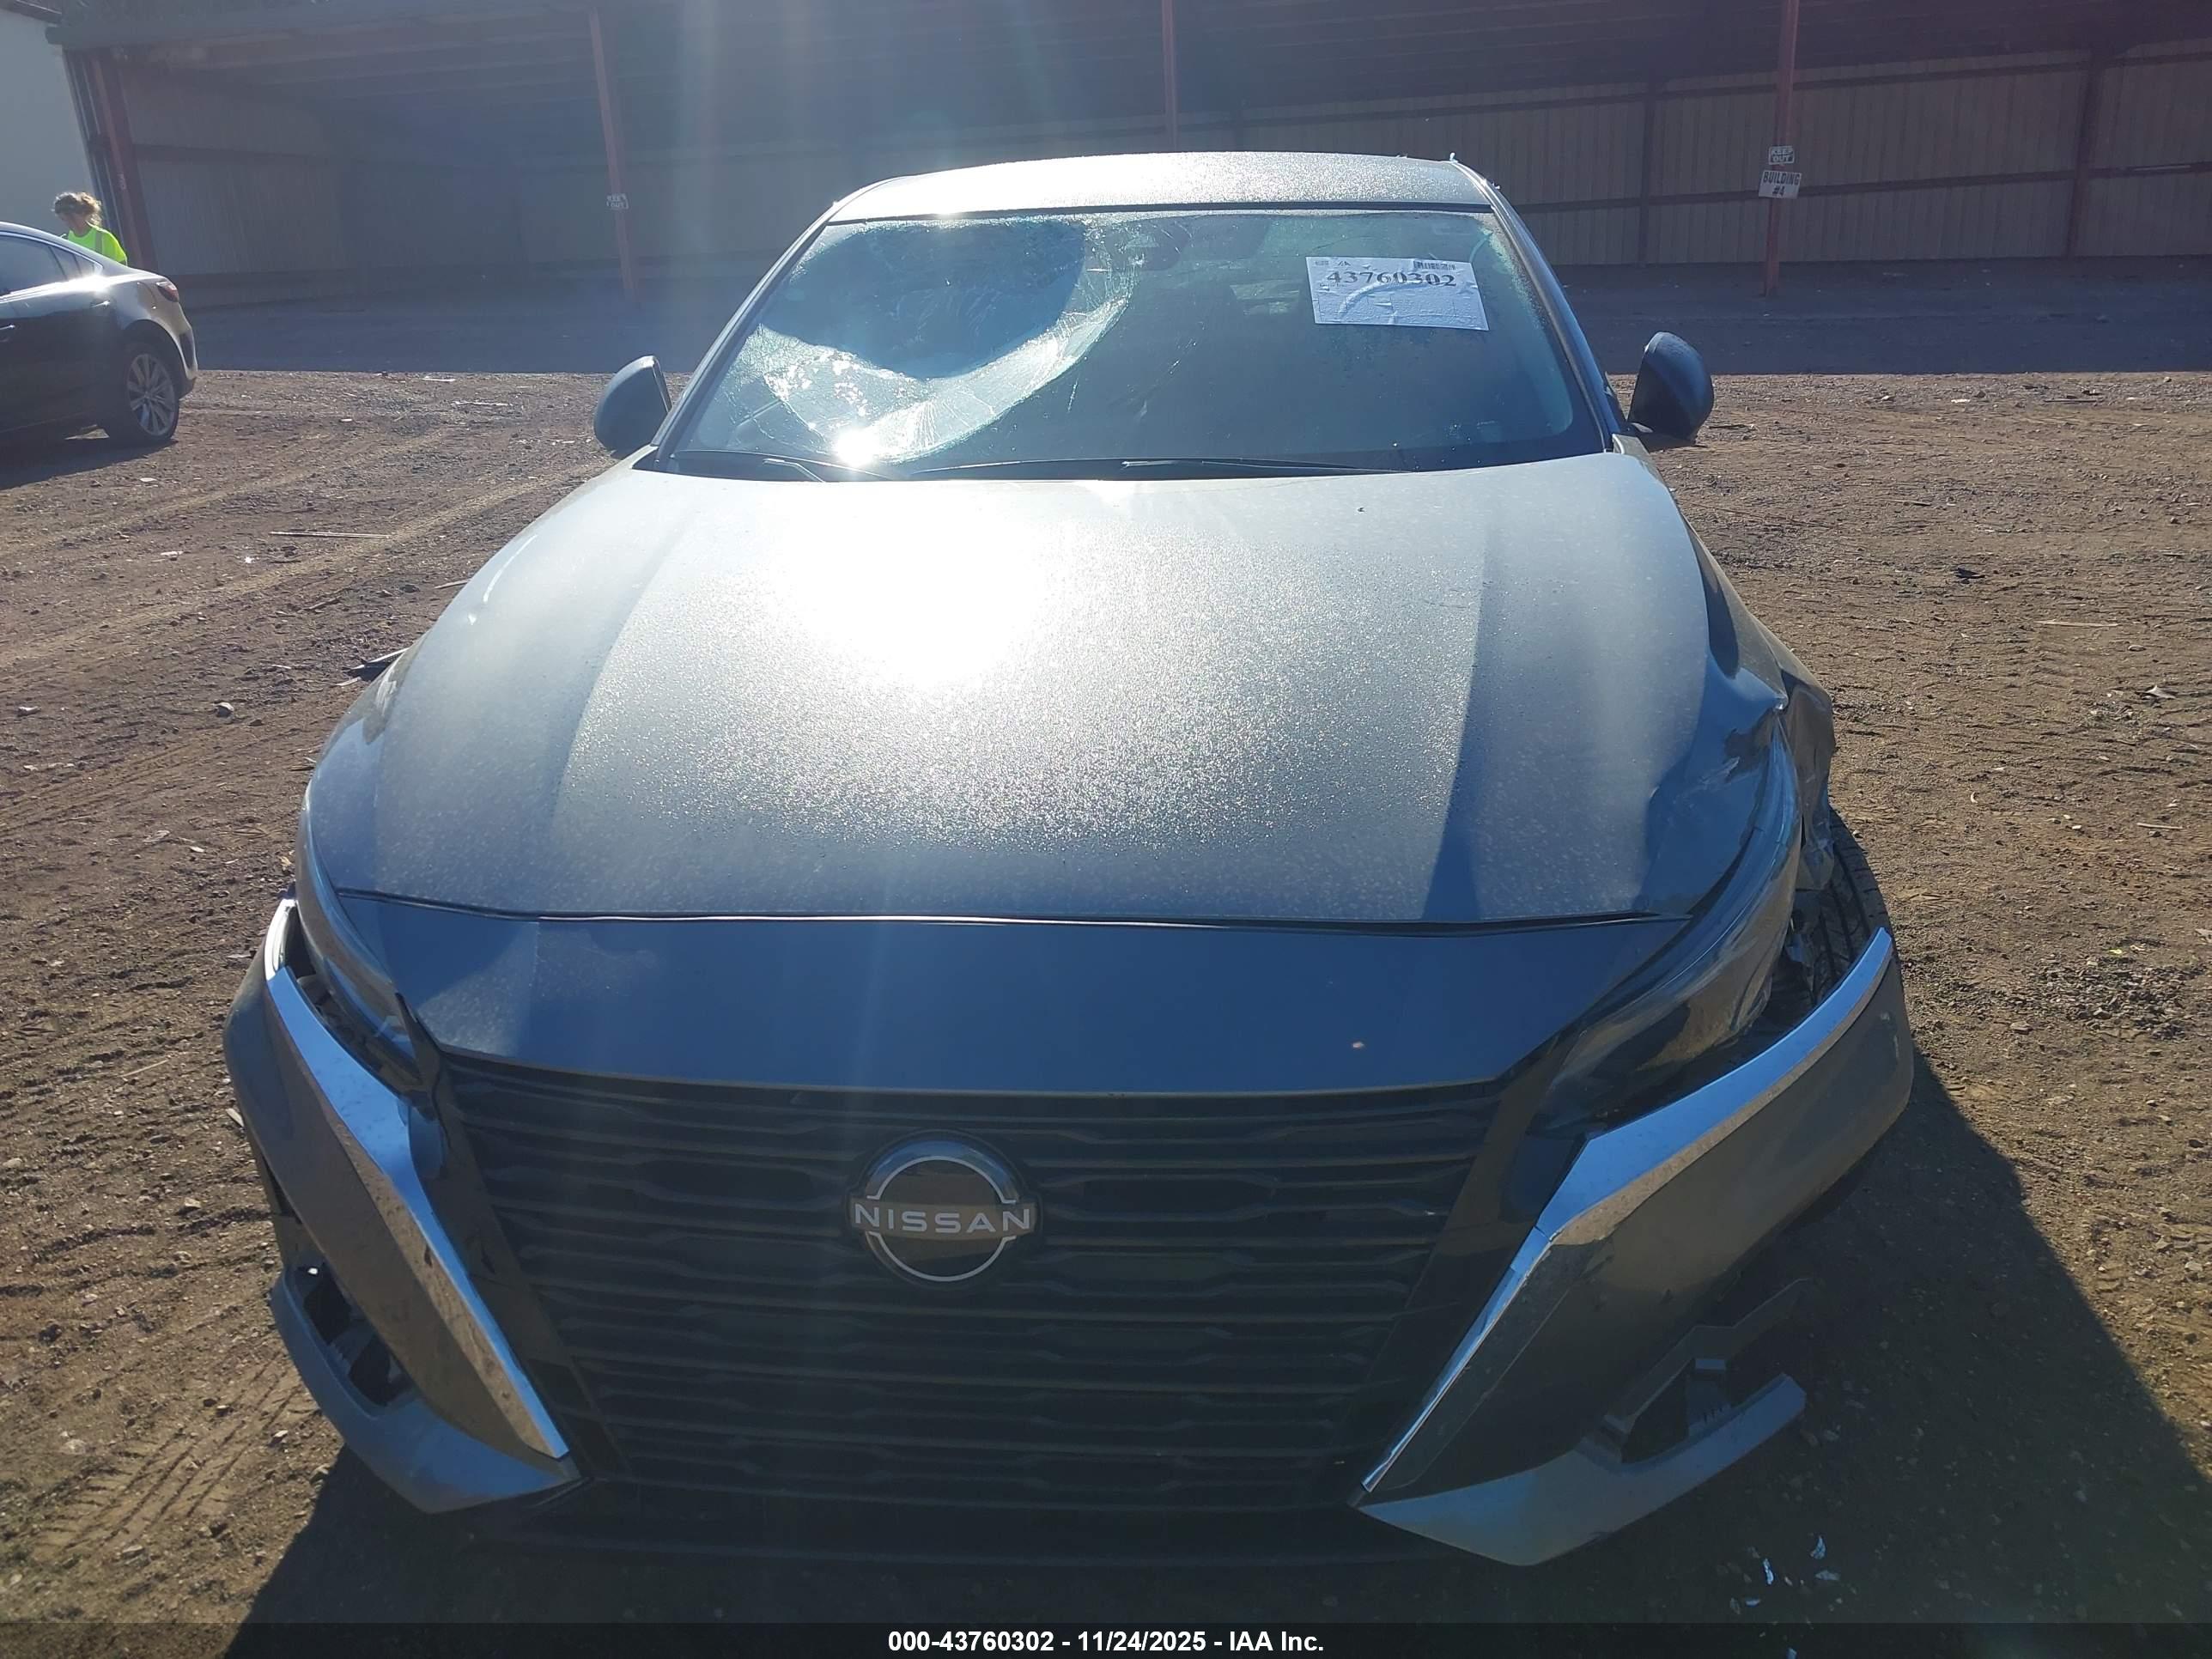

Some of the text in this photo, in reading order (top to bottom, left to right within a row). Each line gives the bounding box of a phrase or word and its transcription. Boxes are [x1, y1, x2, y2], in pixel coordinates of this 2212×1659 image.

[1763, 171, 1800, 185] BUILDING
[1772, 185, 1785, 196] #4
[1327, 270, 1457, 287] 43760302
[854, 1203, 1030, 1234] NISSAN
